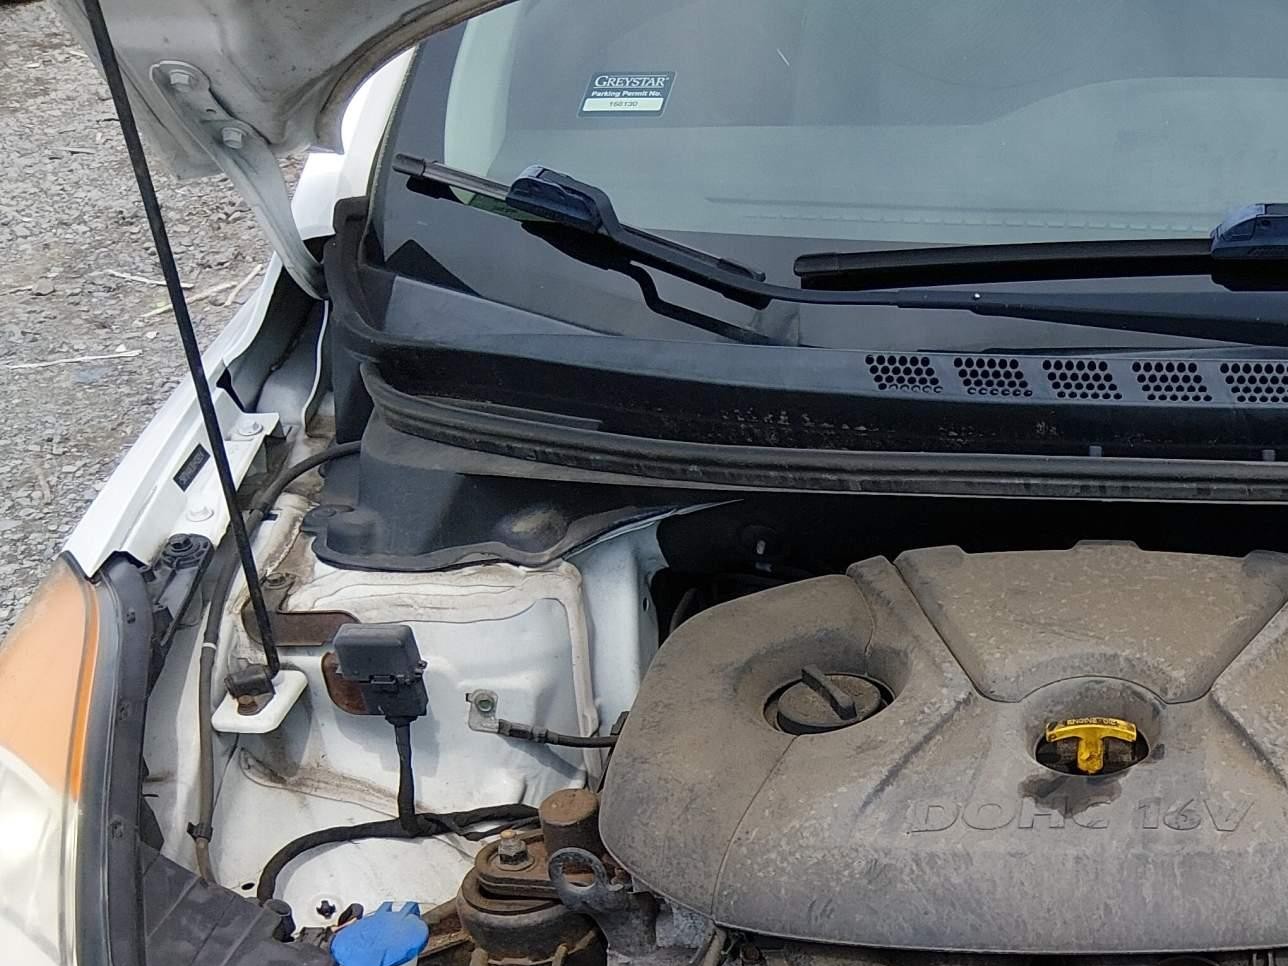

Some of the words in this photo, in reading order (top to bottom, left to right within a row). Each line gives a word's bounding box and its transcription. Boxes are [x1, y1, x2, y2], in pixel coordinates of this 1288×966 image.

[594, 75, 665, 87] GREYSTAR
[591, 90, 621, 98] Parking
[907, 798, 1112, 833] DOHC
[1134, 798, 1255, 832] 16V
